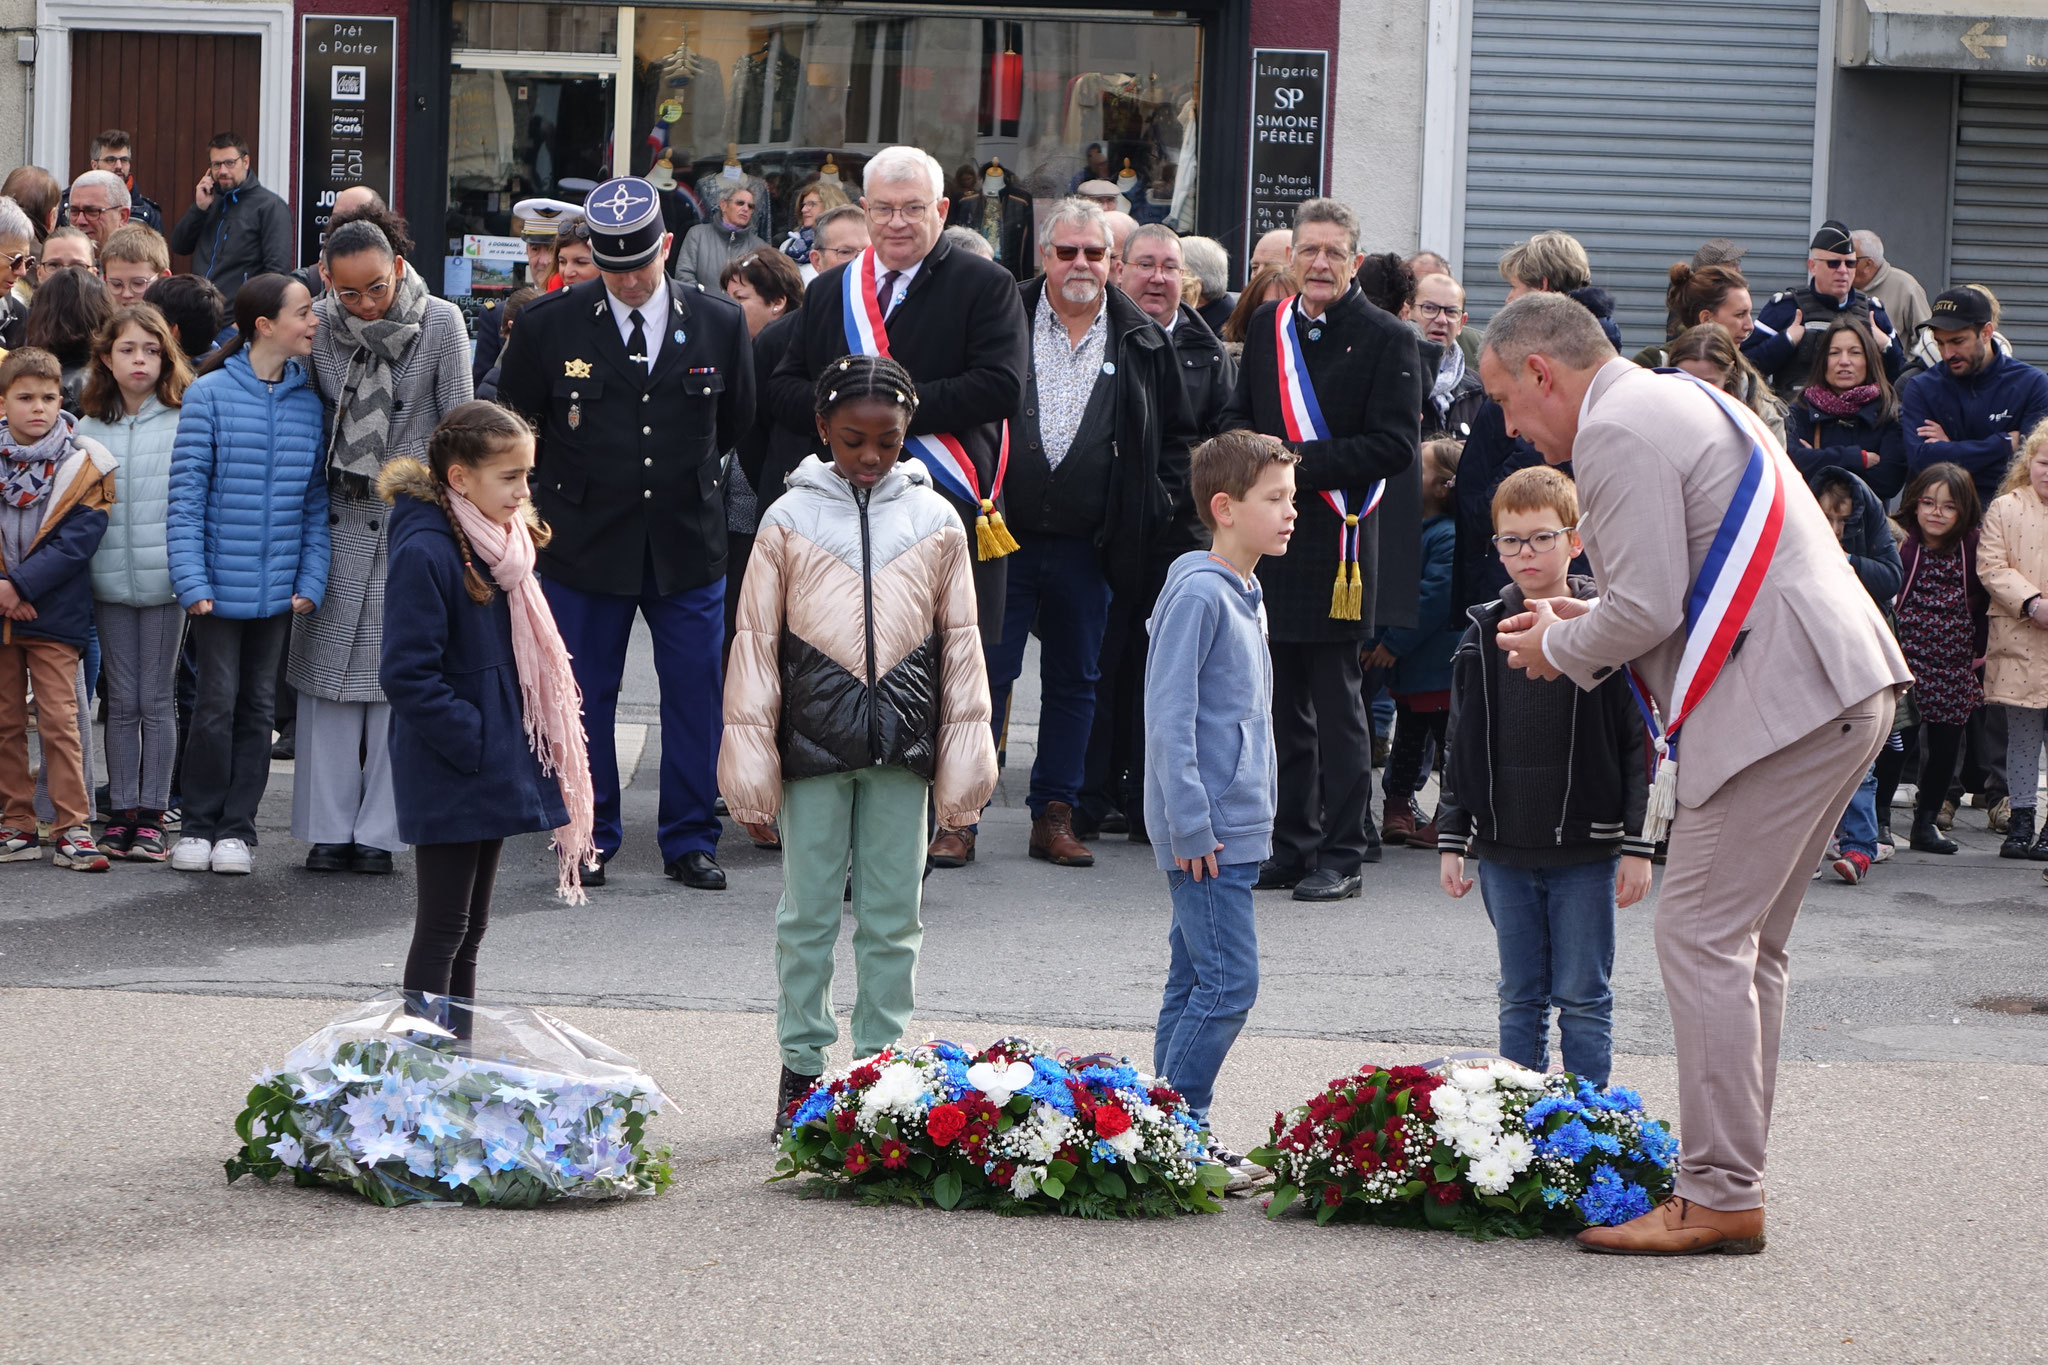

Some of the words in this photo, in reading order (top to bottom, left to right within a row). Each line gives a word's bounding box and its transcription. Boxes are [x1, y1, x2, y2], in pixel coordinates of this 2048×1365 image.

[334, 23, 362, 37] Prêt
[318, 41, 328, 53] à
[334, 40, 378, 54] Porter
[2026, 54, 2048, 67] Ru
[1260, 63, 1319, 78] Lingerie
[1274, 87, 1304, 109] SP
[1256, 114, 1319, 128] SIMONE
[333, 123, 362, 133] Café
[1259, 128, 1314, 143] PÉRÈLE
[1259, 173, 1273, 183] Du
[1278, 174, 1312, 185] Mardi
[1255, 187, 1269, 195] au
[1274, 185, 1315, 196] Samedi
[1257, 207, 1271, 217] 9h
[1276, 209, 1284, 217] à
[1255, 219, 1275, 228] 14h
